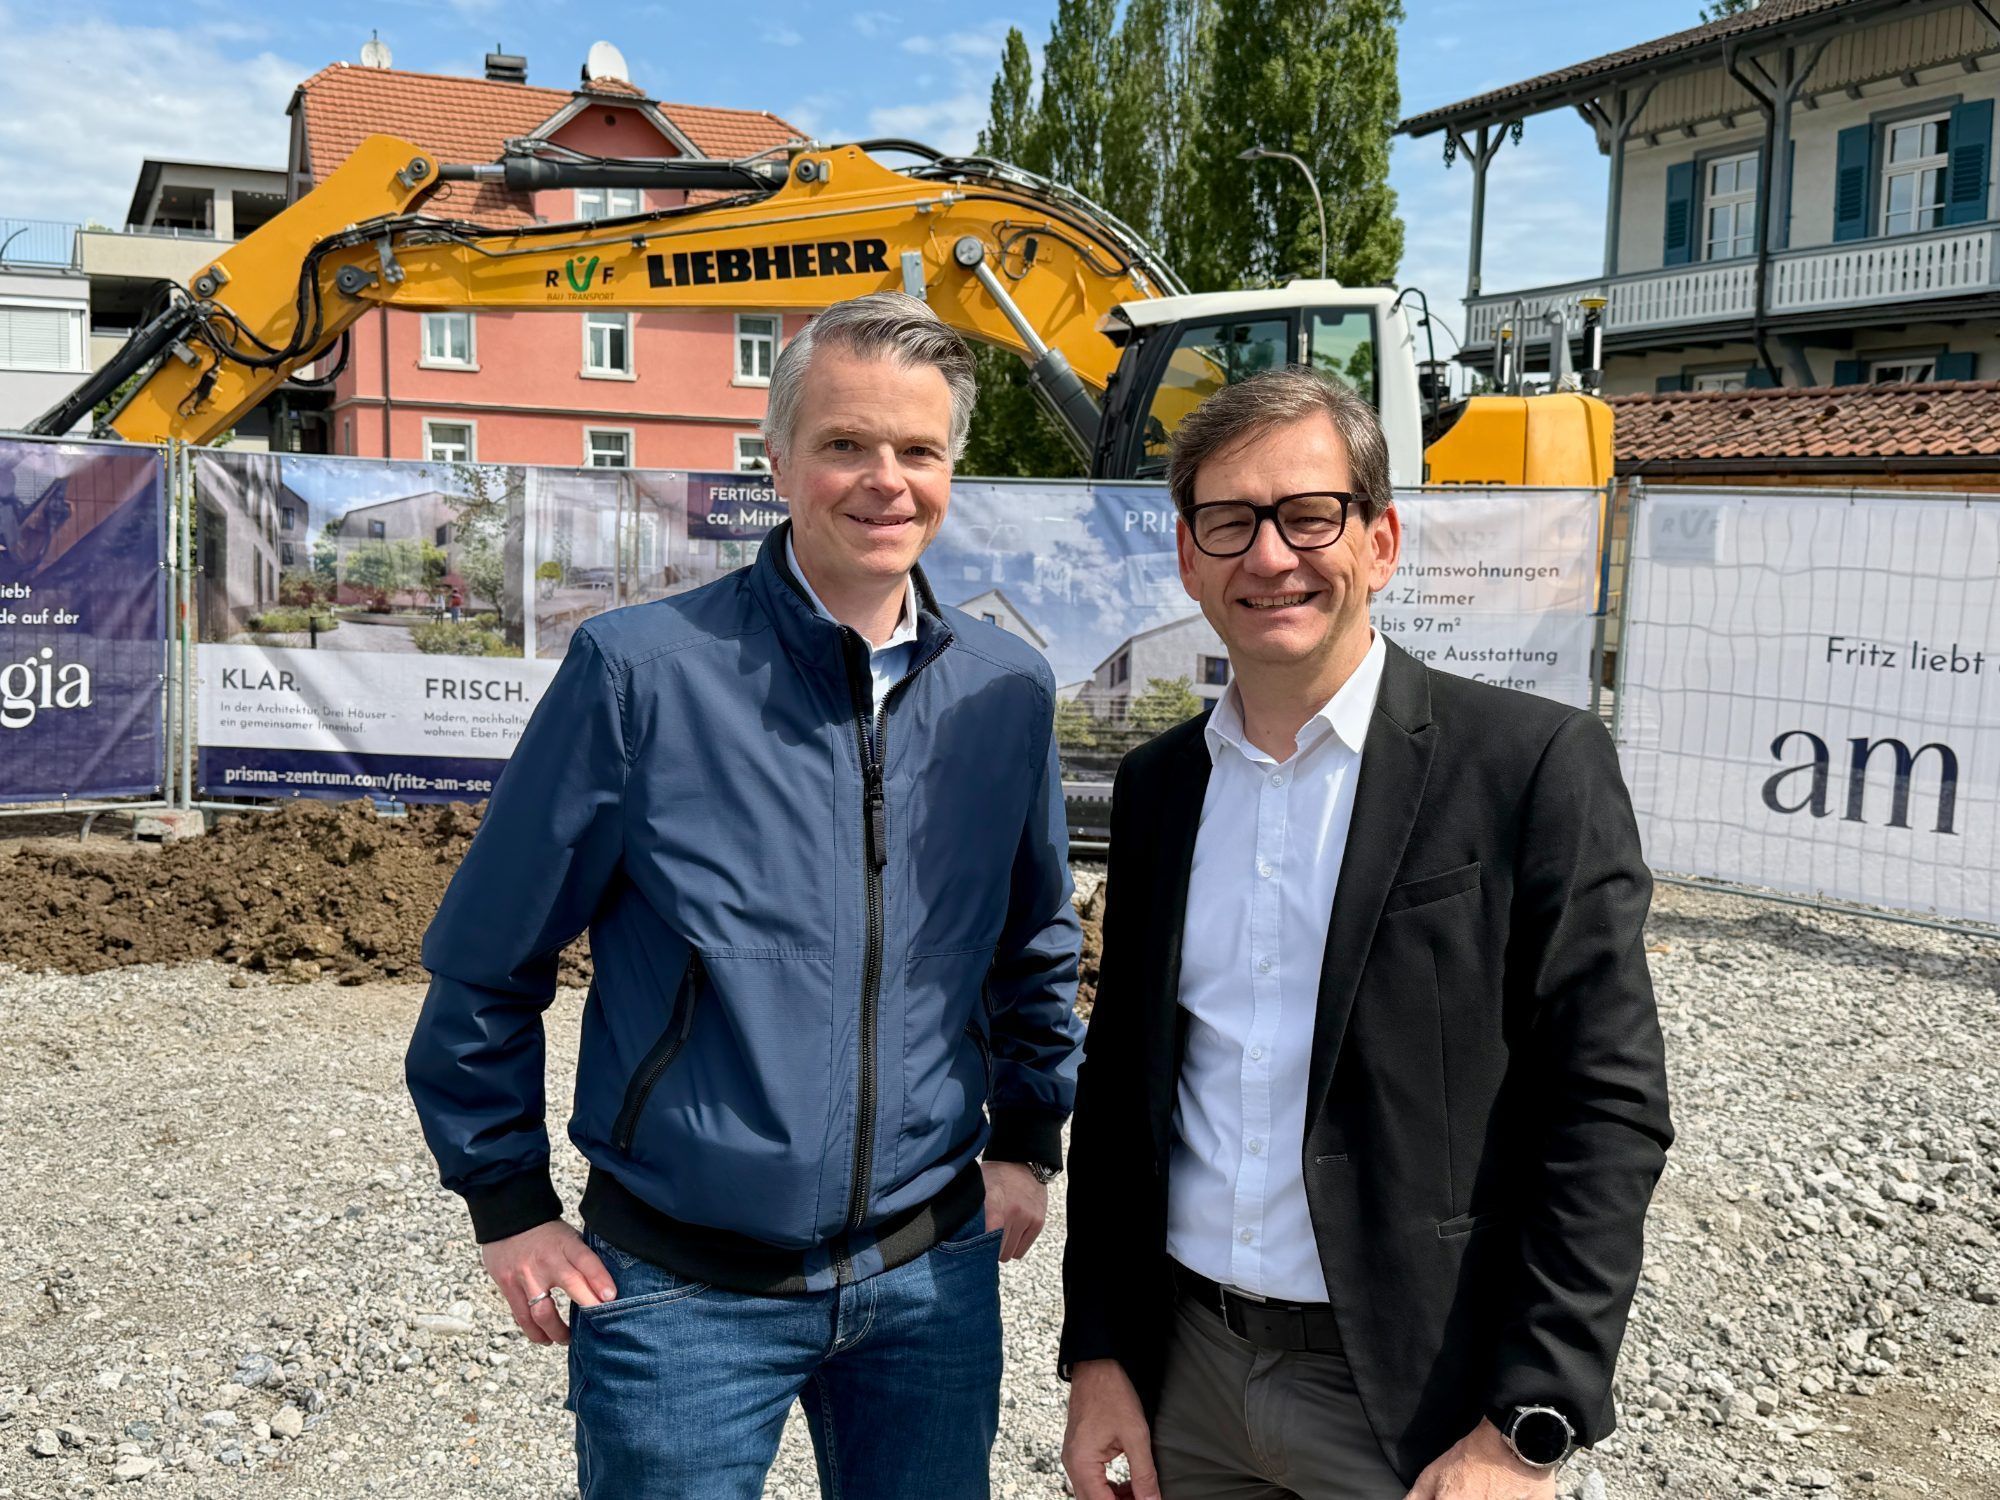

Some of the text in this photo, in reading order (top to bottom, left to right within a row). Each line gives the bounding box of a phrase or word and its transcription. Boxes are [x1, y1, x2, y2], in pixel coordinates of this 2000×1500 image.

[647, 238, 891, 288] LIEBHERR
[568, 292, 615, 301] TRANSPORT
[706, 512, 733, 525] ca.
[1384, 588, 1475, 605] 4-Zimmer
[22, 608, 49, 624] auf
[53, 608, 80, 624] der
[1381, 615, 1405, 632] bis
[1413, 617, 1434, 632] 97
[1444, 645, 1558, 666] Ausstattung
[1826, 636, 1985, 675] Fritz liebt
[222, 668, 301, 693] KLAR.
[425, 678, 529, 703] FRISCH.
[221, 703, 231, 712] In
[235, 702, 253, 713] der
[323, 707, 344, 718] Drei
[348, 709, 387, 720] Häuser
[424, 712, 468, 724] Modern,
[220, 718, 367, 734] ein gemeinsamer Innenhof.
[471, 727, 498, 739] Eben
[225, 767, 492, 792] prisma-zentrum.com/fritz-am-see
[1761, 730, 1960, 836] am
